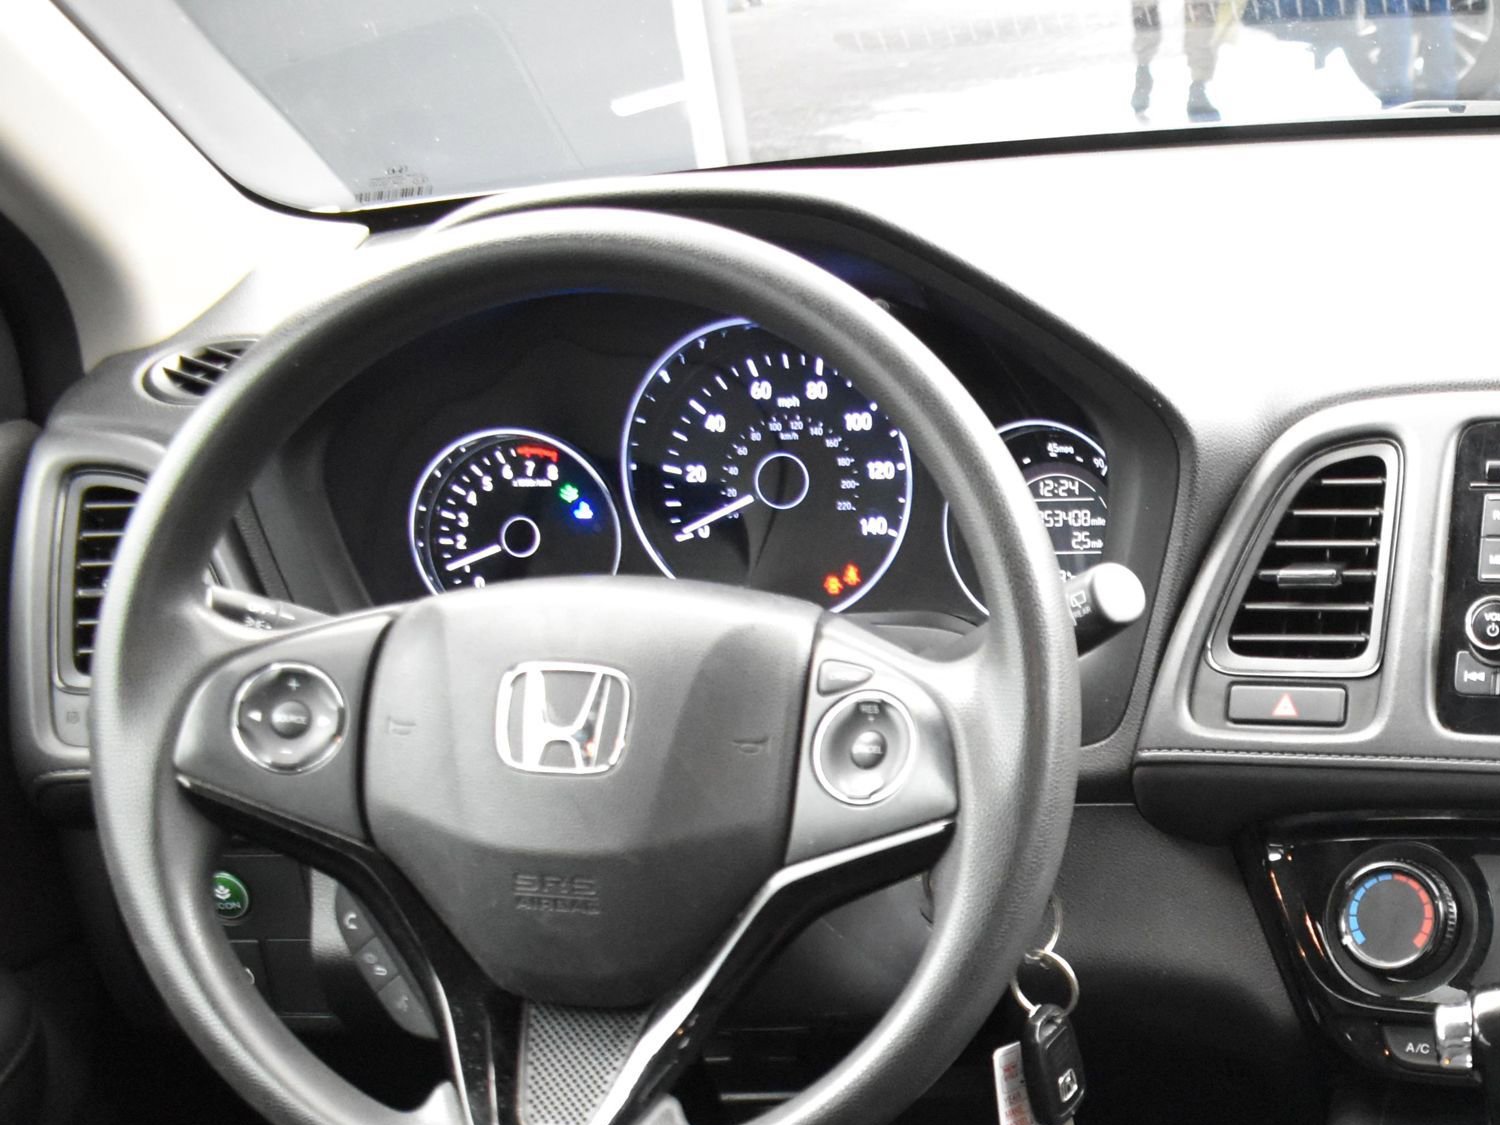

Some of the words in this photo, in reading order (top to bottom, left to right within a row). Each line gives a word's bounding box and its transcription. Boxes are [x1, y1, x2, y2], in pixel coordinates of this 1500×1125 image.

[750, 380, 773, 400] 60
[805, 380, 829, 400] 80
[776, 395, 801, 409] mph
[704, 413, 727, 433] 40
[768, 421, 783, 432] 100
[789, 420, 804, 431] 120
[844, 411, 873, 431] 100
[502, 463, 514, 481] 6
[524, 460, 536, 477] 7
[547, 463, 560, 481] 8
[685, 464, 707, 483] 20
[866, 461, 896, 481] 120
[482, 475, 494, 492] 5
[1038, 480, 1080, 497] 12:24
[466, 490, 478, 507] 4
[457, 511, 470, 528] 3
[859, 515, 889, 536] 140
[455, 534, 468, 550] 2
[1404, 1042, 1431, 1055] A/C
